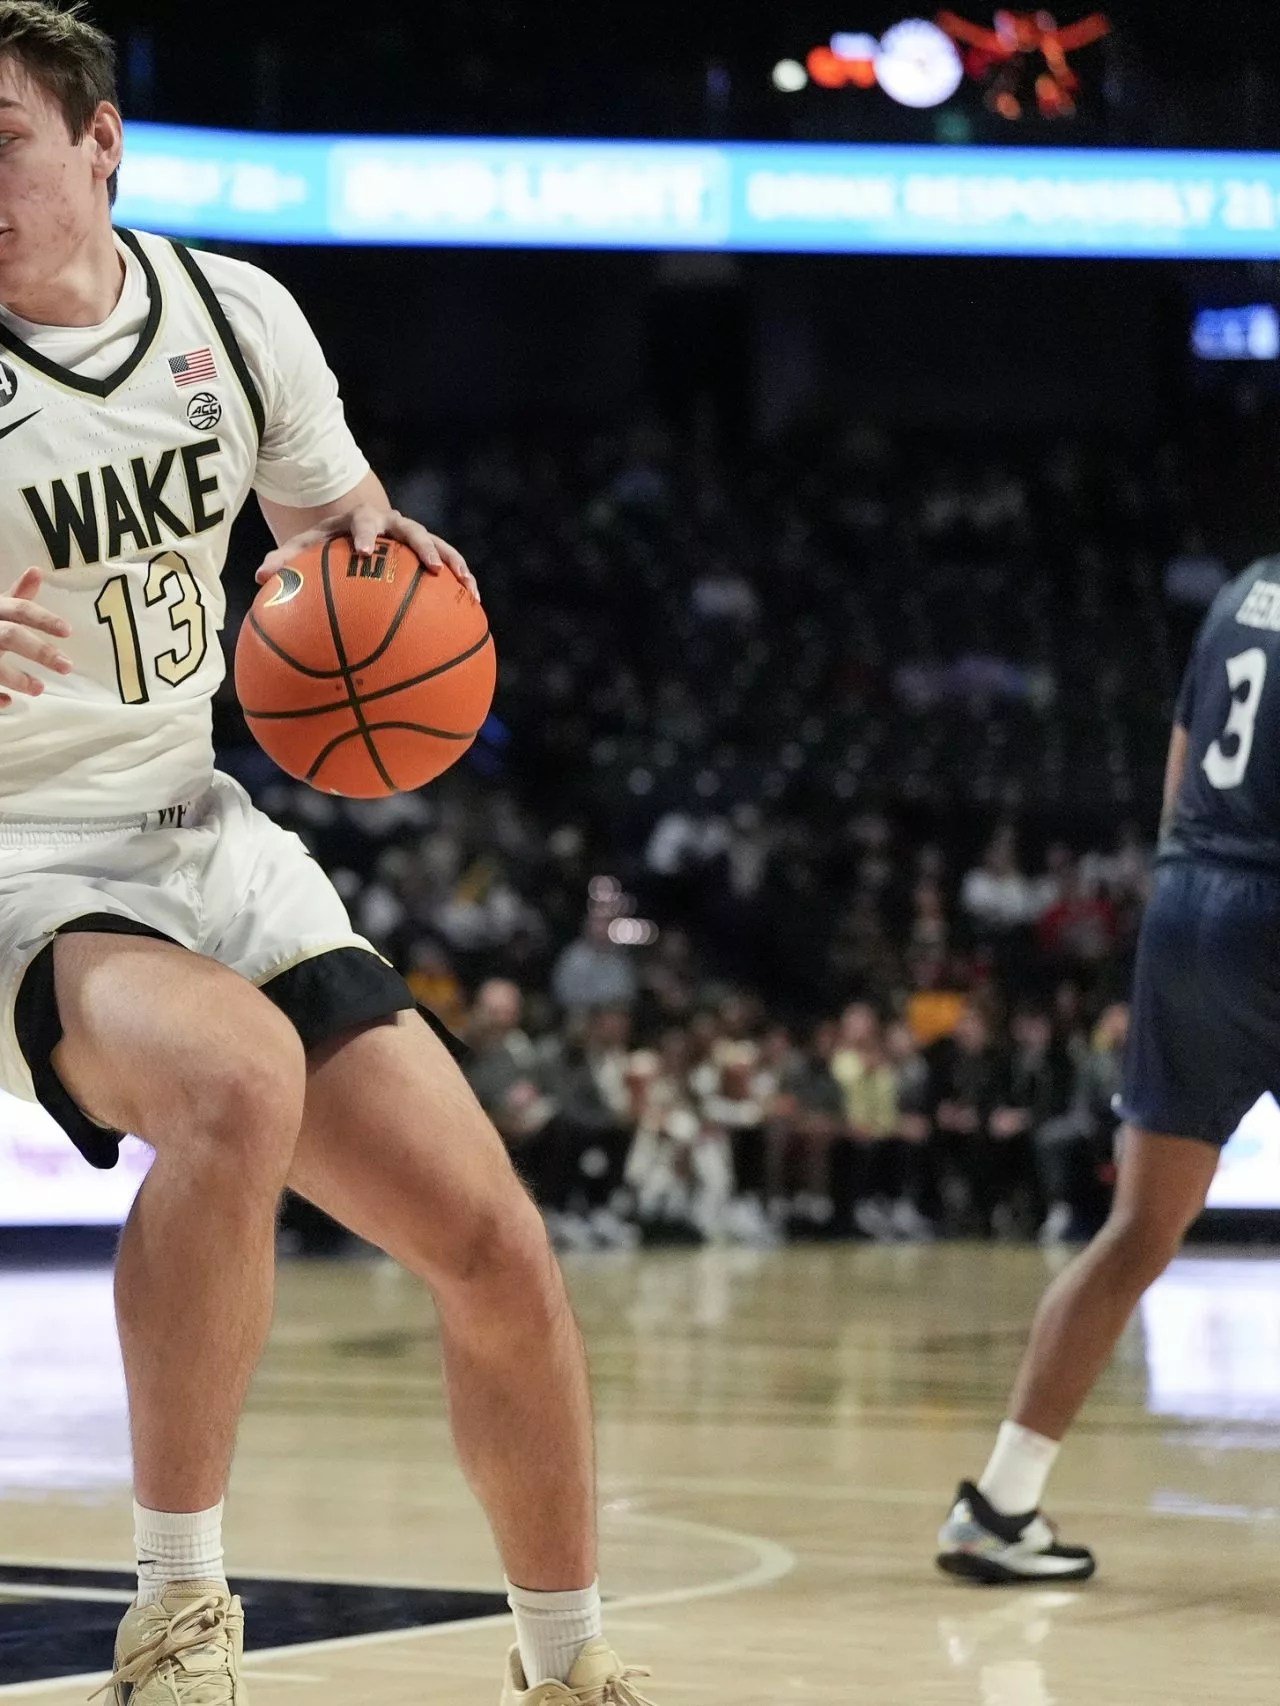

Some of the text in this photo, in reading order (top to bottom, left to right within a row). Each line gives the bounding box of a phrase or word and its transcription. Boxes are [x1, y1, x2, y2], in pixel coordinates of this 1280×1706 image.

[190, 401, 219, 417] ACC
[19, 437, 225, 571] WAKE
[94, 550, 208, 705] 13
[1200, 647, 1268, 790] 3
